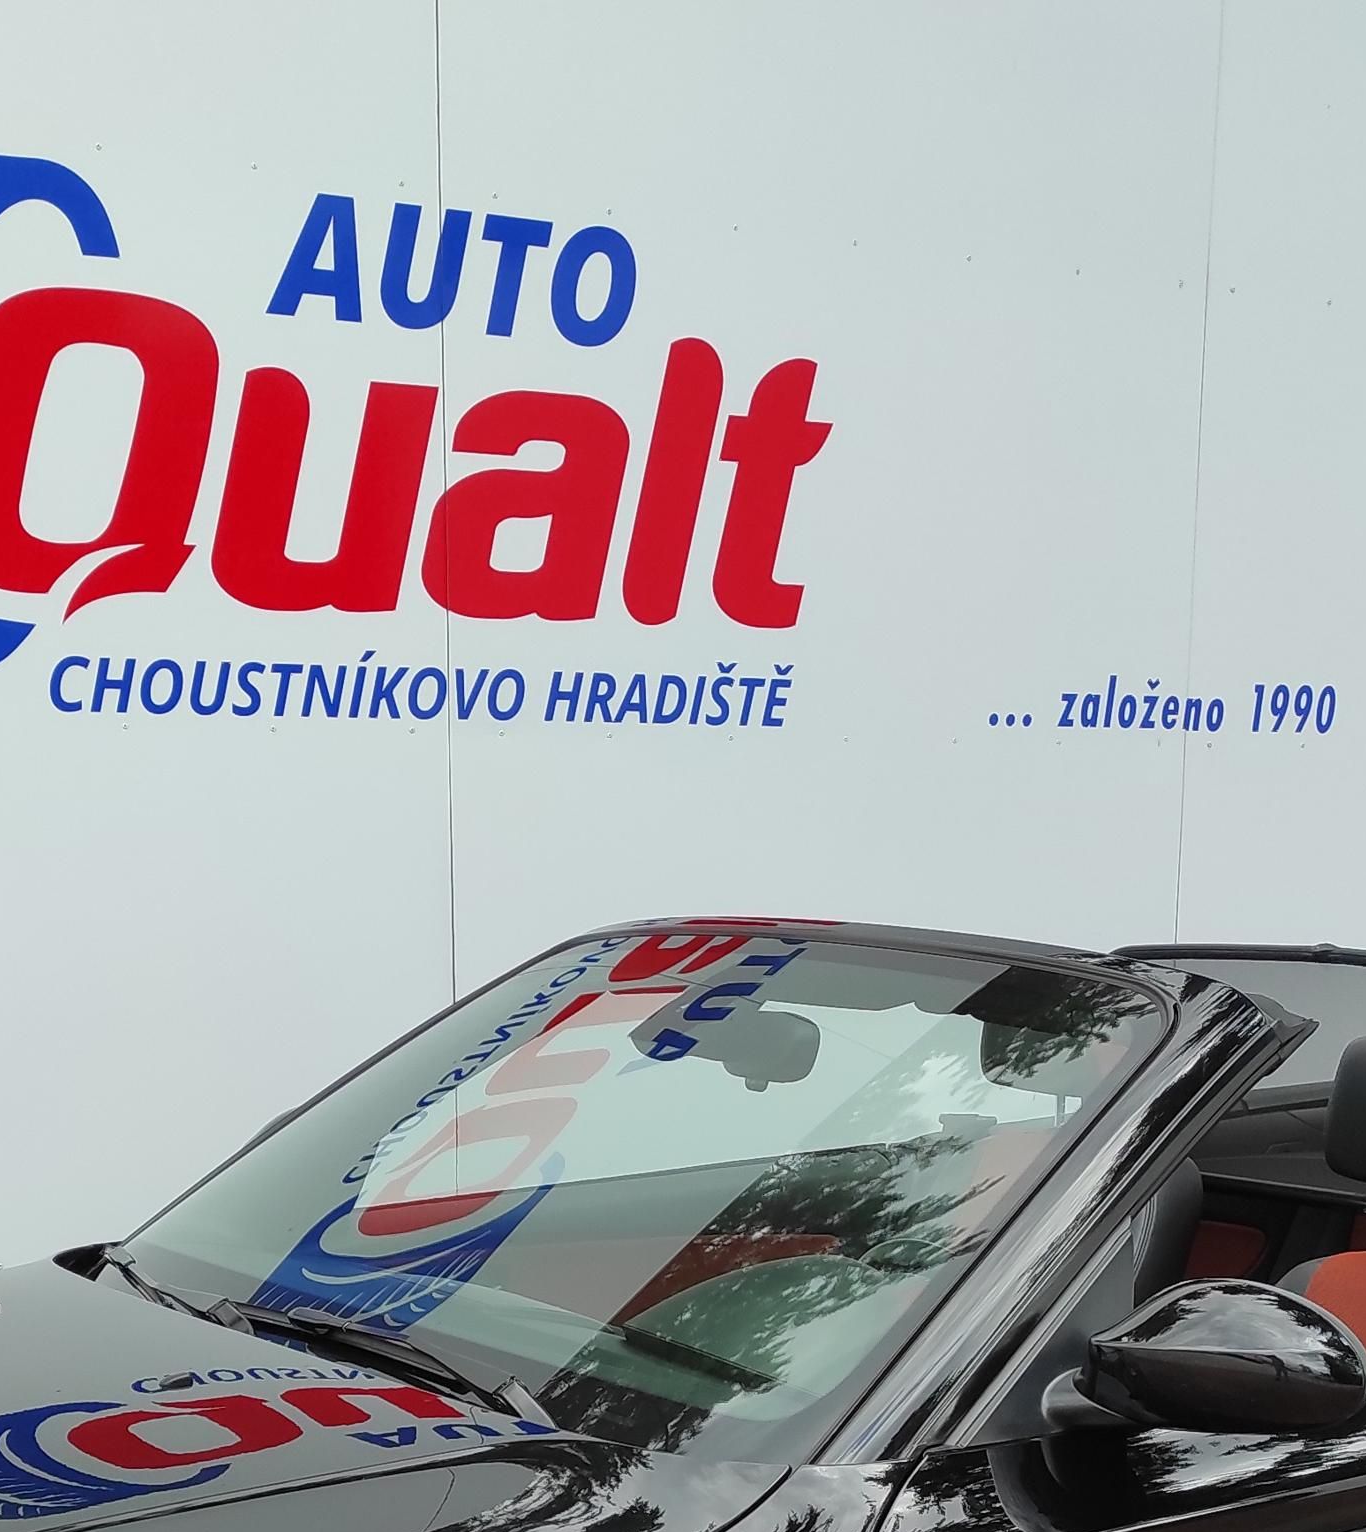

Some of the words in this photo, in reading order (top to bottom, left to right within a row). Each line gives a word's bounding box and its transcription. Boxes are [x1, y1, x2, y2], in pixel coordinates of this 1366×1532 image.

[266, 191, 638, 348] AUTO
[48, 649, 527, 722] CHOUSTNÍKOVO
[543, 661, 793, 728] HRADIŠTĚ
[1057, 674, 1225, 733] založeno
[1251, 683, 1337, 735] 1990
